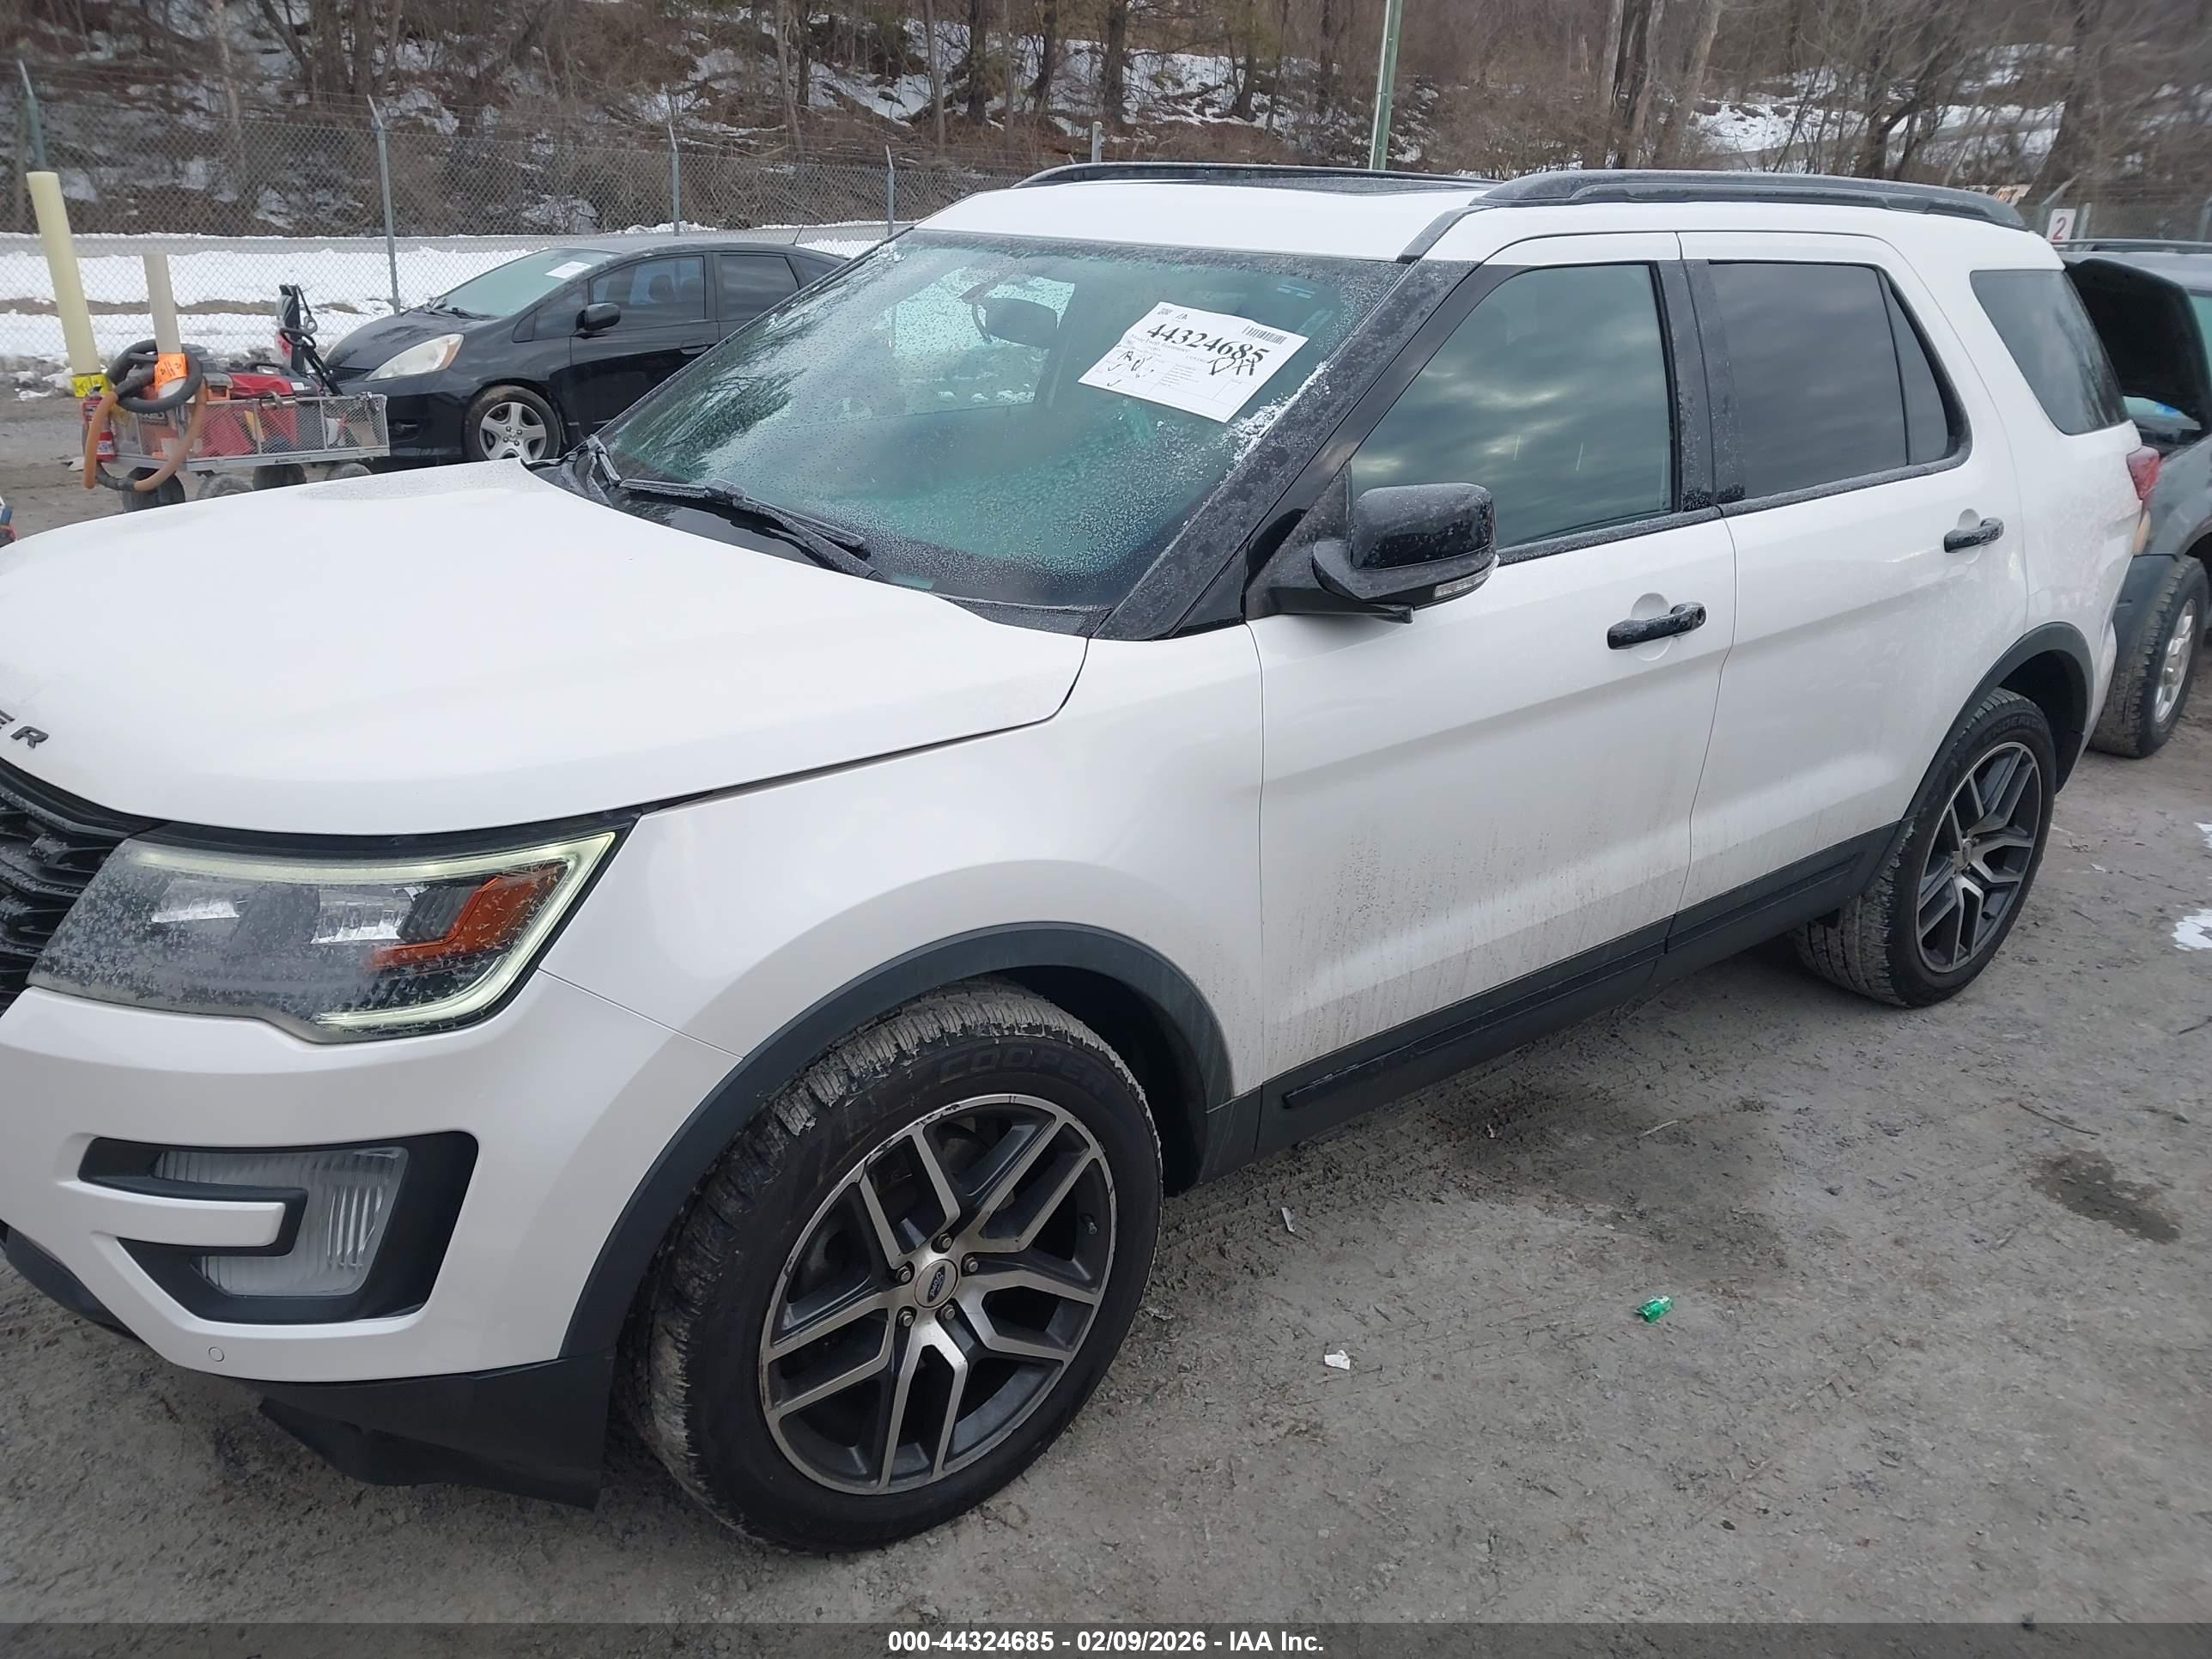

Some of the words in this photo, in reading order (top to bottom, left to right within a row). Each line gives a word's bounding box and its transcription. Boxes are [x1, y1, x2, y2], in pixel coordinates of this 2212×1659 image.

[2053, 217, 2066, 240] 2
[1147, 324, 1271, 362] 44324685
[939, 1044, 1108, 1092] COOPER
